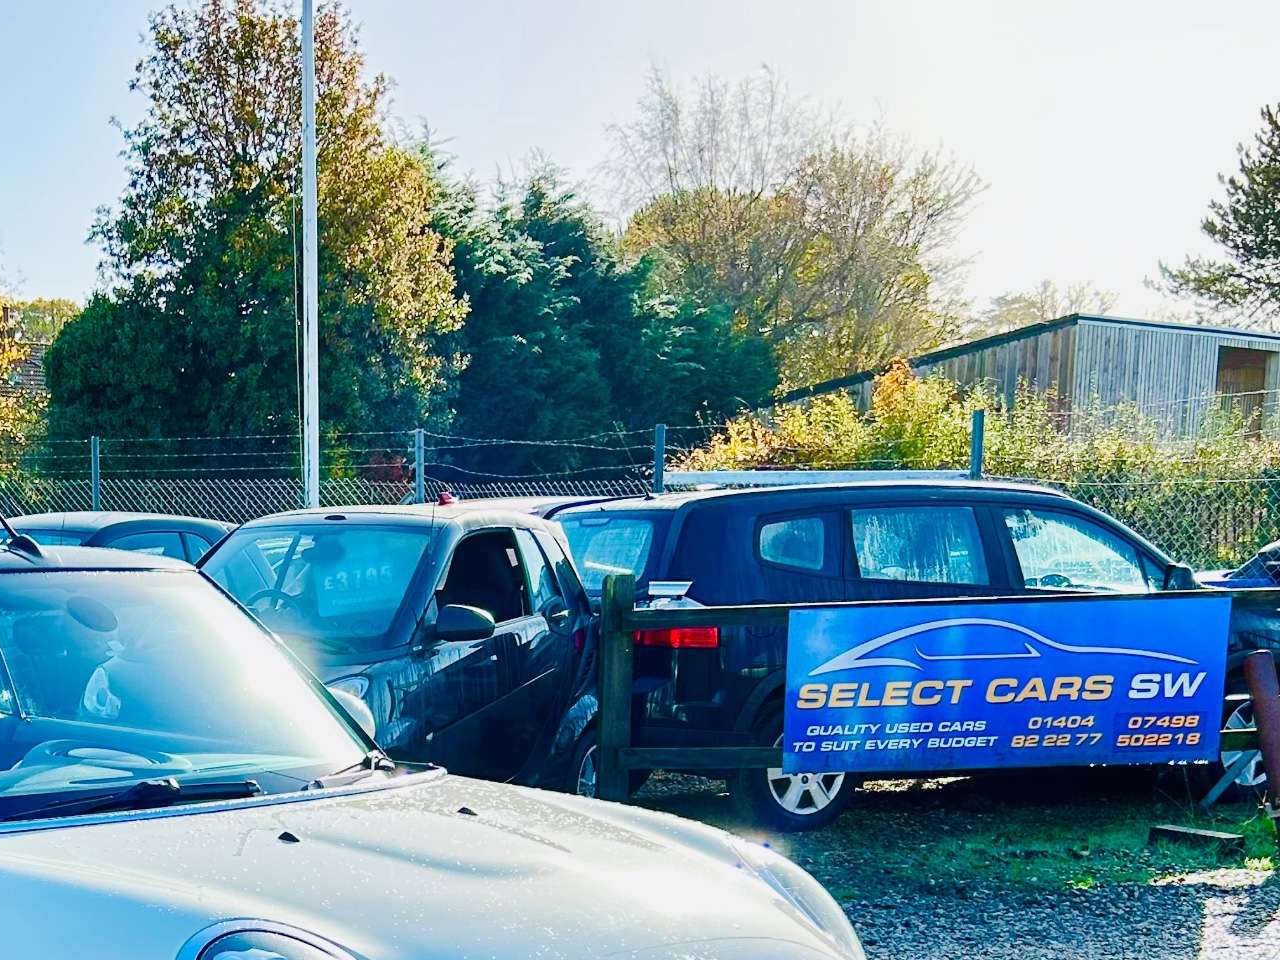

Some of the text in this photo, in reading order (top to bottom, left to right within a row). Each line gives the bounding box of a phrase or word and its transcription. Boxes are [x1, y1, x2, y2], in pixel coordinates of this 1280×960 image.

[796, 672, 1207, 709] SELECT CARS SW
[806, 720, 987, 736] QUALITY USED CARS
[1028, 715, 1095, 730] 01404
[1127, 715, 1200, 729] 07498
[793, 735, 999, 752] TO SUIT EVERY BUDGET
[1010, 733, 1103, 748] 82 22 77
[1116, 733, 1201, 747] 502218
